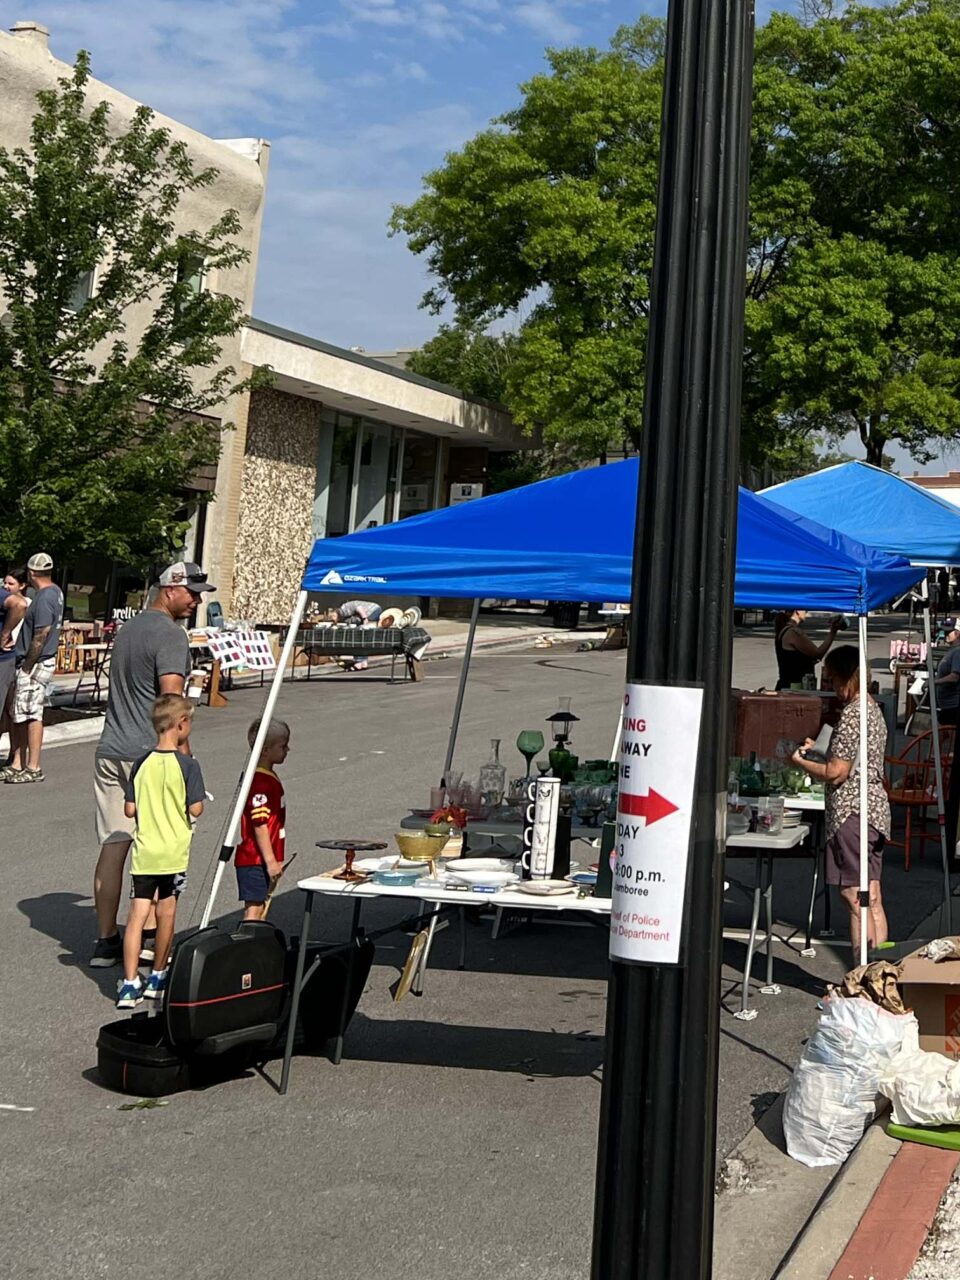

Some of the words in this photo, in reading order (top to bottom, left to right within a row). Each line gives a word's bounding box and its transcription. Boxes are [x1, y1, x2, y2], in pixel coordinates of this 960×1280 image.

[636, 870, 666, 883] p.m.
[632, 913, 660, 926] Police
[619, 925, 669, 941] Department
